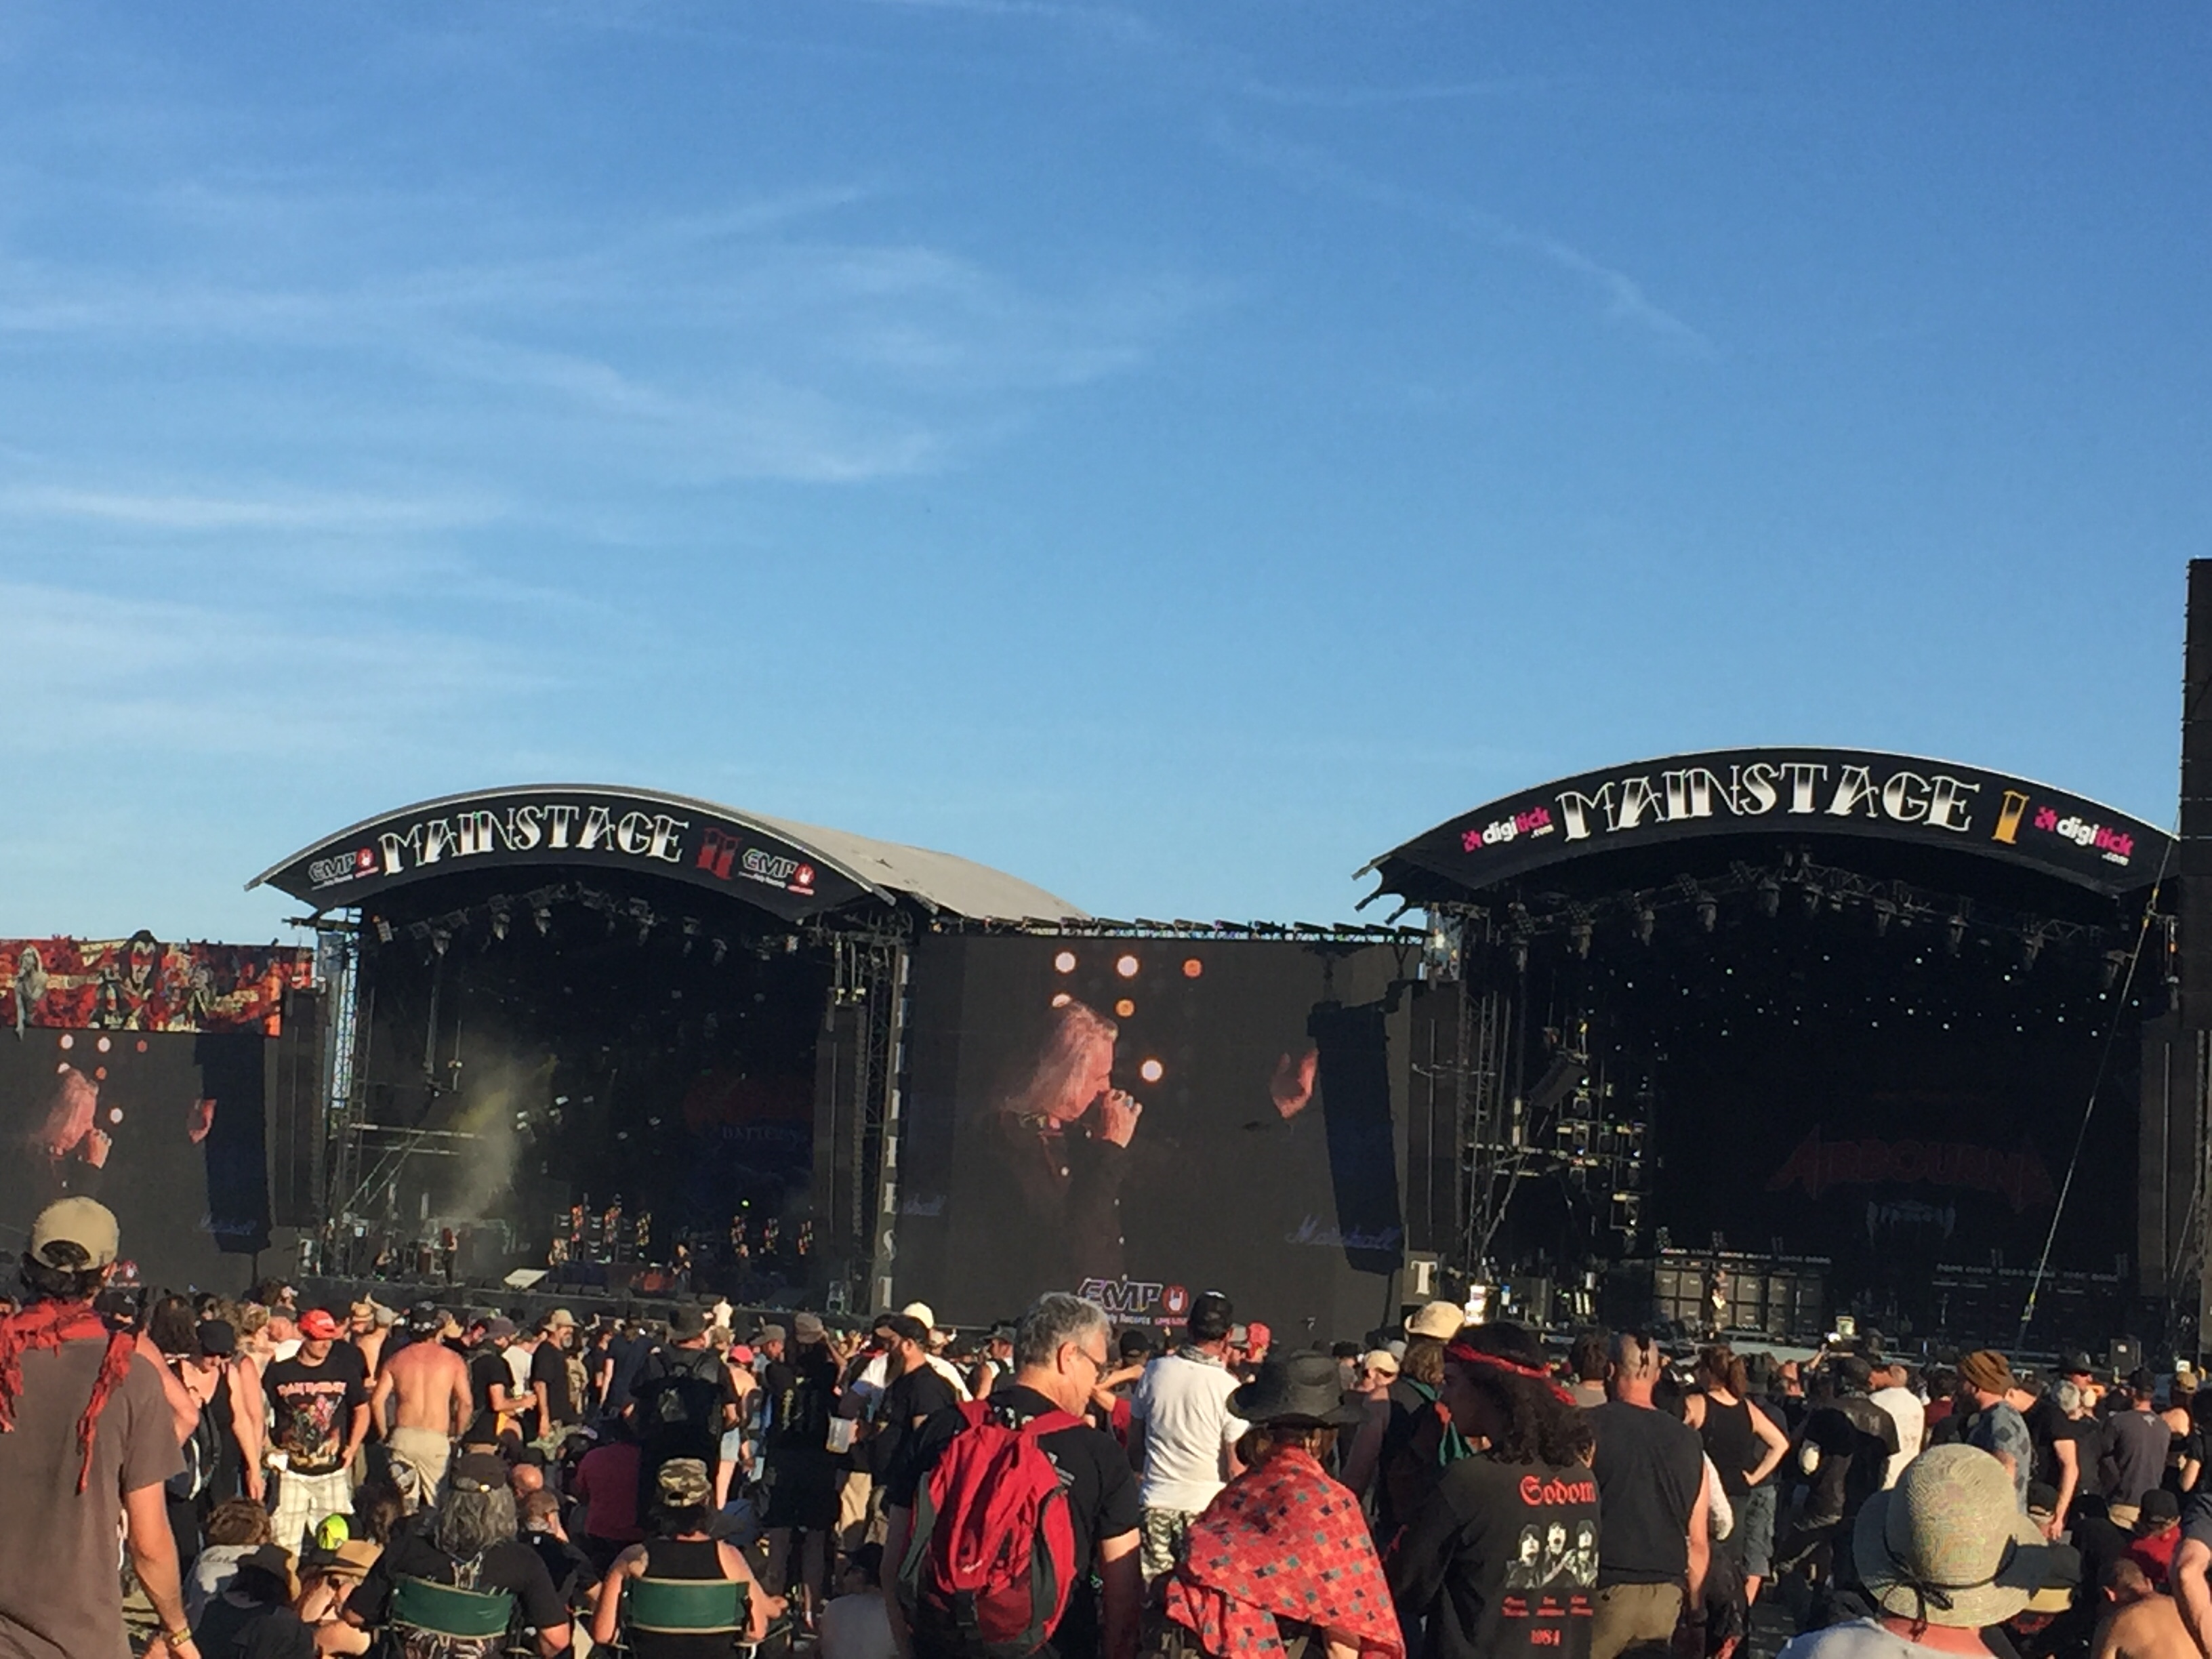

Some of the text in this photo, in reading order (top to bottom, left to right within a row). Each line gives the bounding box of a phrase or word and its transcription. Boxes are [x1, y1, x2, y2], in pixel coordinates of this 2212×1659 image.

[1555, 762, 1980, 842] MAINSTAGE
[377, 804, 689, 876] MAINSTAGE
[2056, 816, 2133, 856] digitick
[1078, 1278, 1163, 1312] EMP
[1520, 1475, 1597, 1505] Sodom
